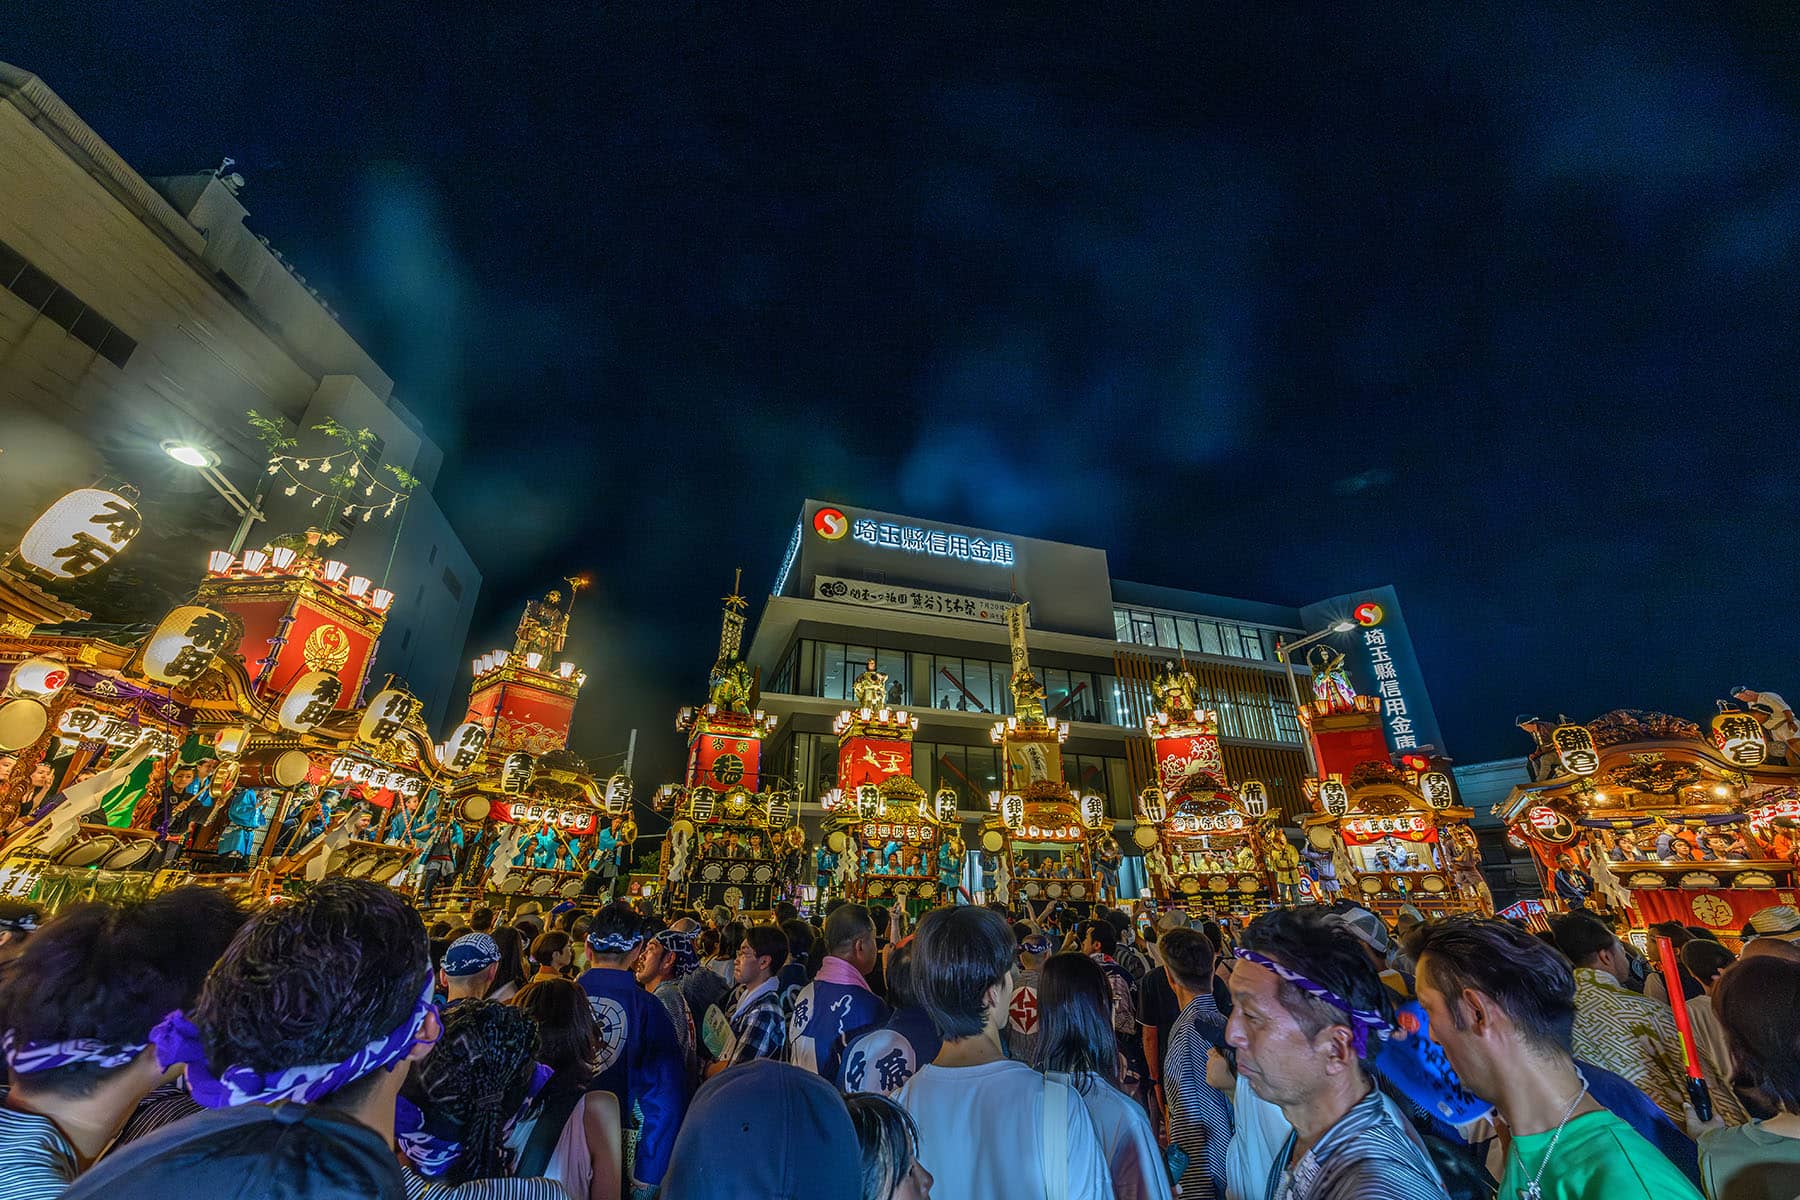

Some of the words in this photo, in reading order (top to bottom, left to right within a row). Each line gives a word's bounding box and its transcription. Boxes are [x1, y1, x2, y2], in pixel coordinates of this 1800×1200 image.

[854, 519, 1014, 564] 埼玉縣信用金庫
[911, 592, 976, 616] 熊谷うちわ祭
[1425, 774, 1452, 809] 伊勢町
